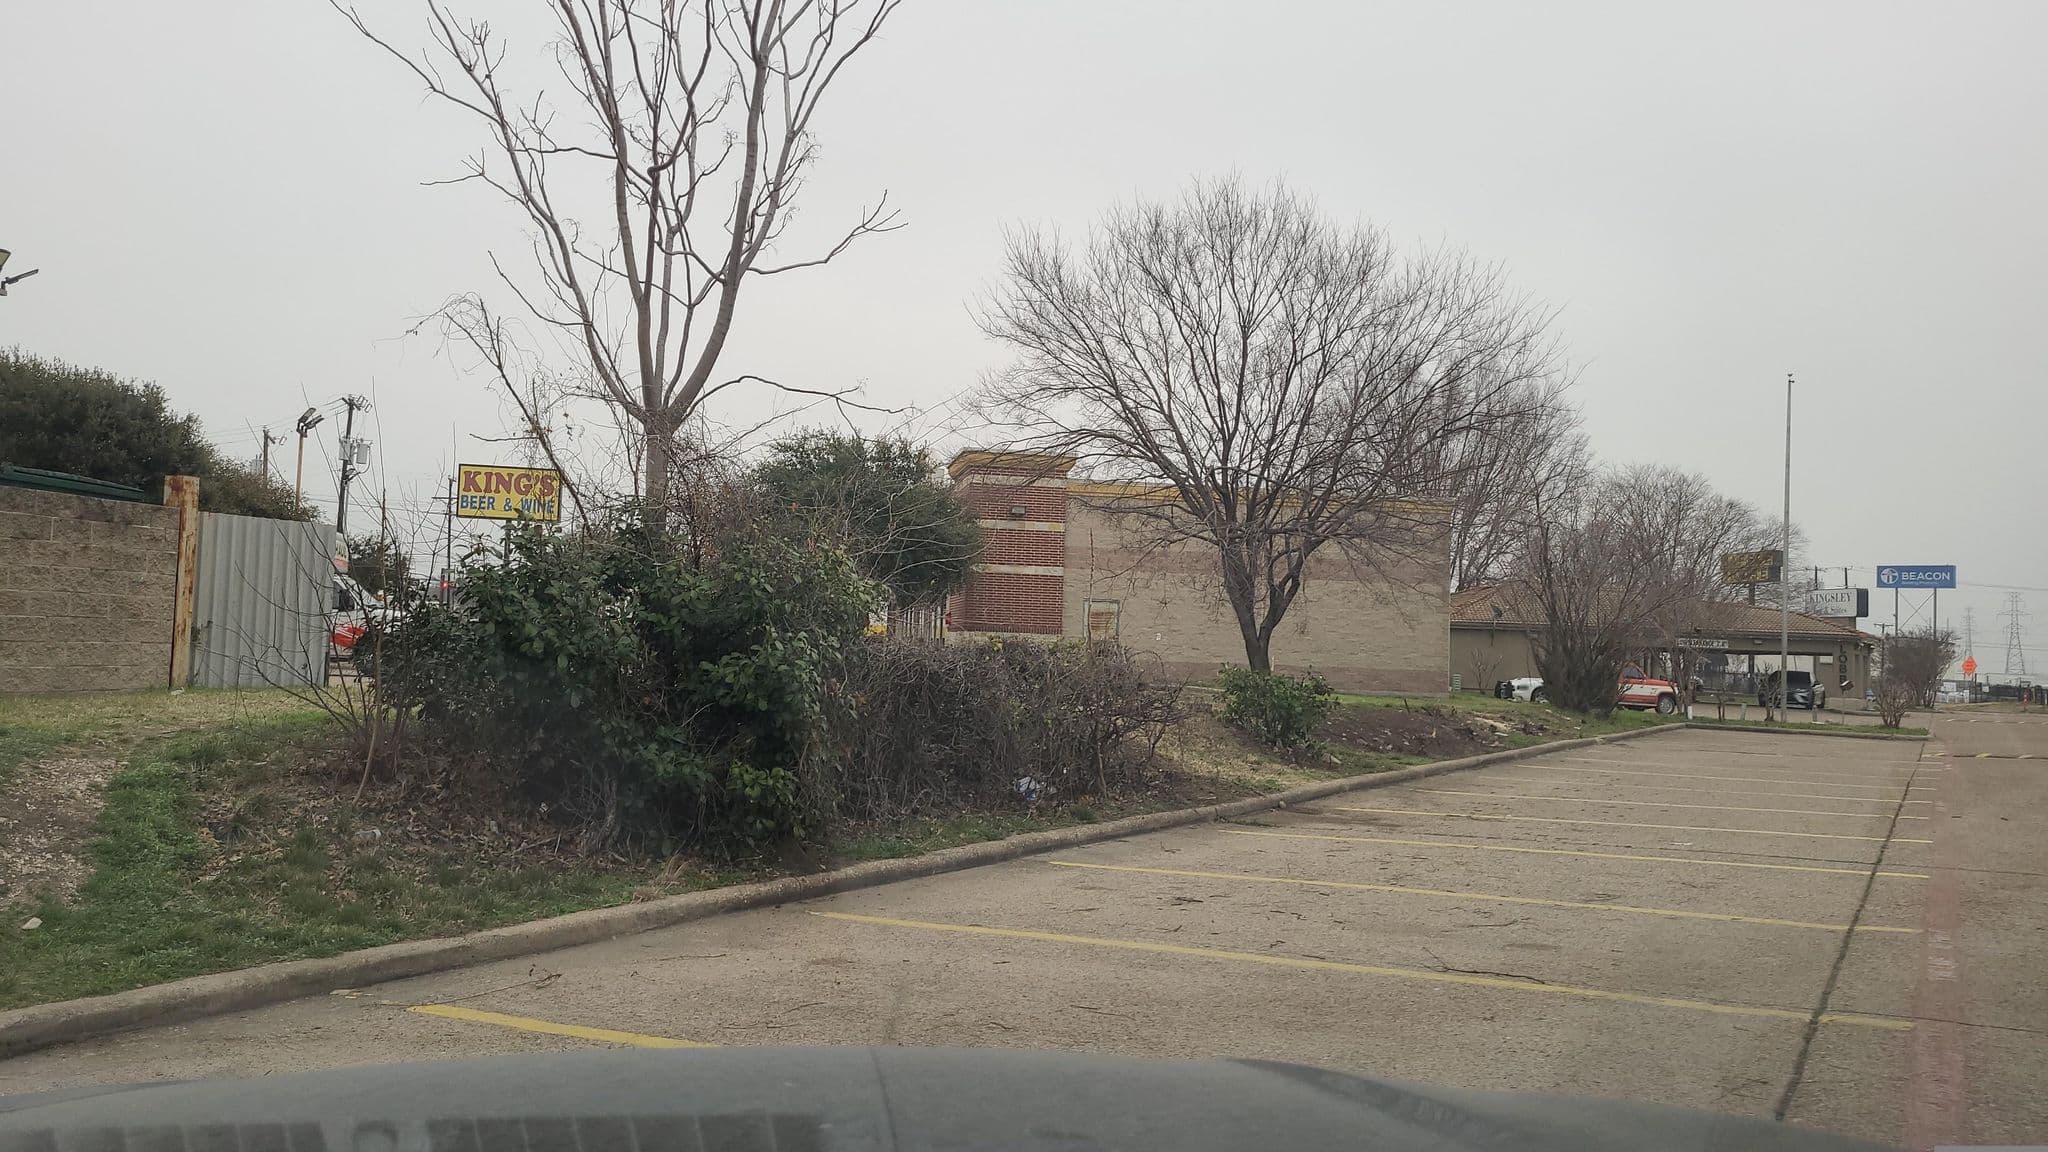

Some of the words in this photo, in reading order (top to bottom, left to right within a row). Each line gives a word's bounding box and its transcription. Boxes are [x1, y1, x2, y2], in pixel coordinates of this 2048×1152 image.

[462, 470, 555, 497] KING'S
[460, 494, 496, 511] BEER
[503, 497, 512, 511] &
[521, 498, 554, 514] WINE
[1901, 571, 1951, 580] BEACON
[1809, 592, 1851, 603] KINGSLEY
[1839, 642, 1848, 687] LOBB
